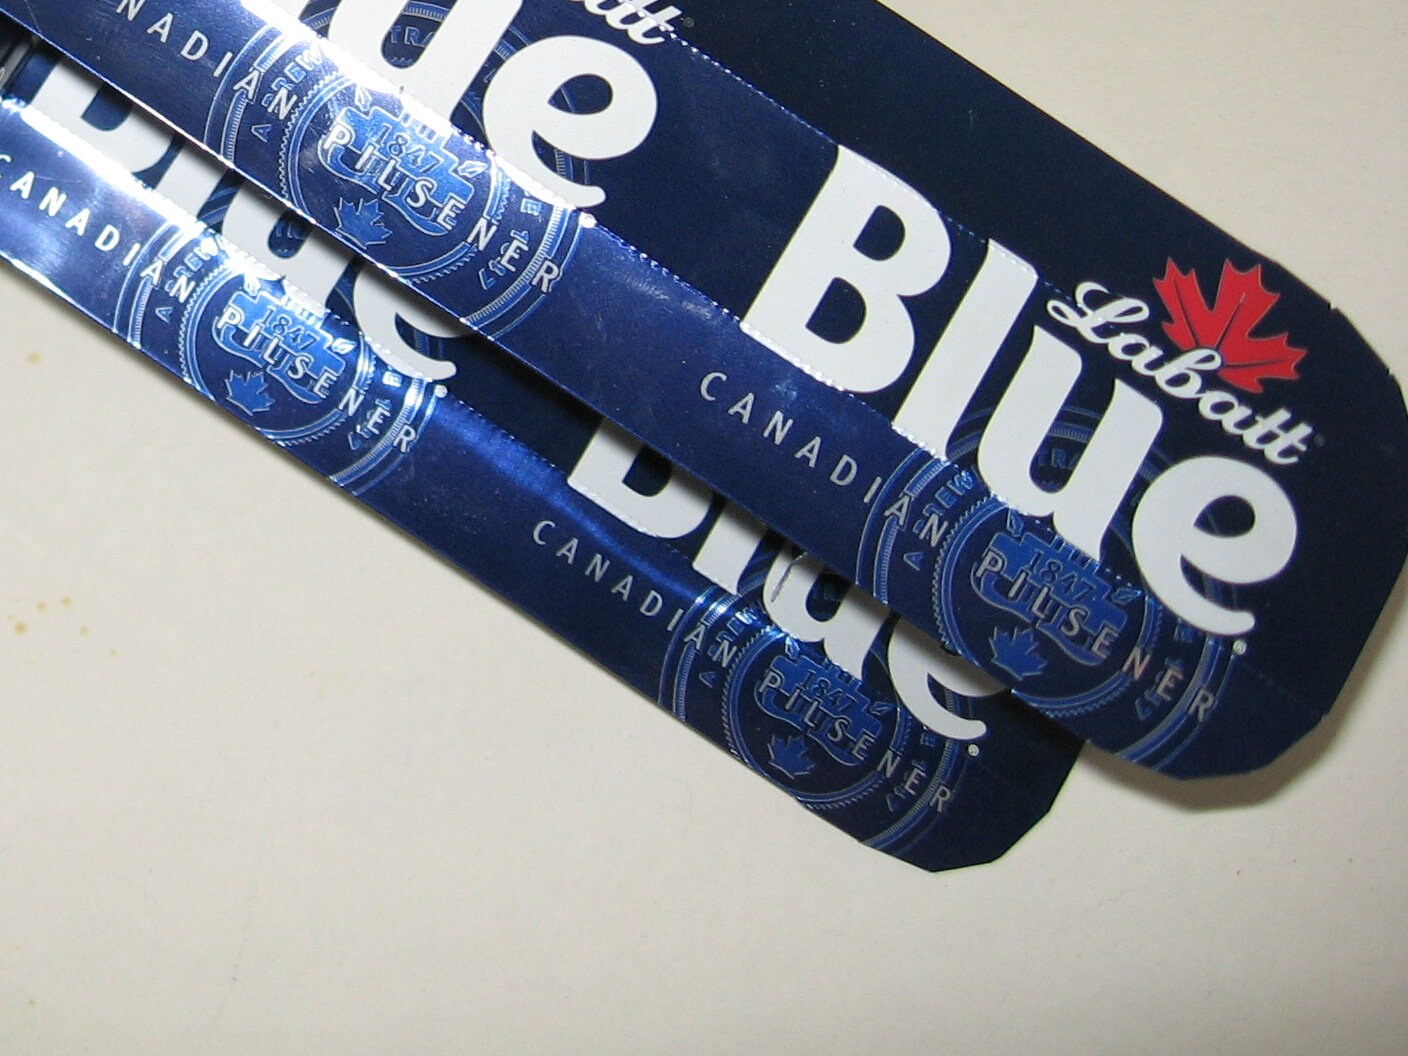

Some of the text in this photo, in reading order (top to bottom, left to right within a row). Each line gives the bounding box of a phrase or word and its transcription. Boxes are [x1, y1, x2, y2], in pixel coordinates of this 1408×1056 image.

[323, 119, 558, 293] PILSENER
[370, 120, 444, 180] 1847
[216, 305, 417, 453] PILSENER
[260, 305, 321, 351] 1847
[742, 144, 1298, 636] Blue
[1048, 280, 1318, 469] Labatt
[699, 370, 1216, 719] CANADIAN PILSENER
[1022, 547, 1098, 607] 1847
[535, 517, 954, 814] CANADIAN PILSENER
[797, 666, 859, 717] 1847
